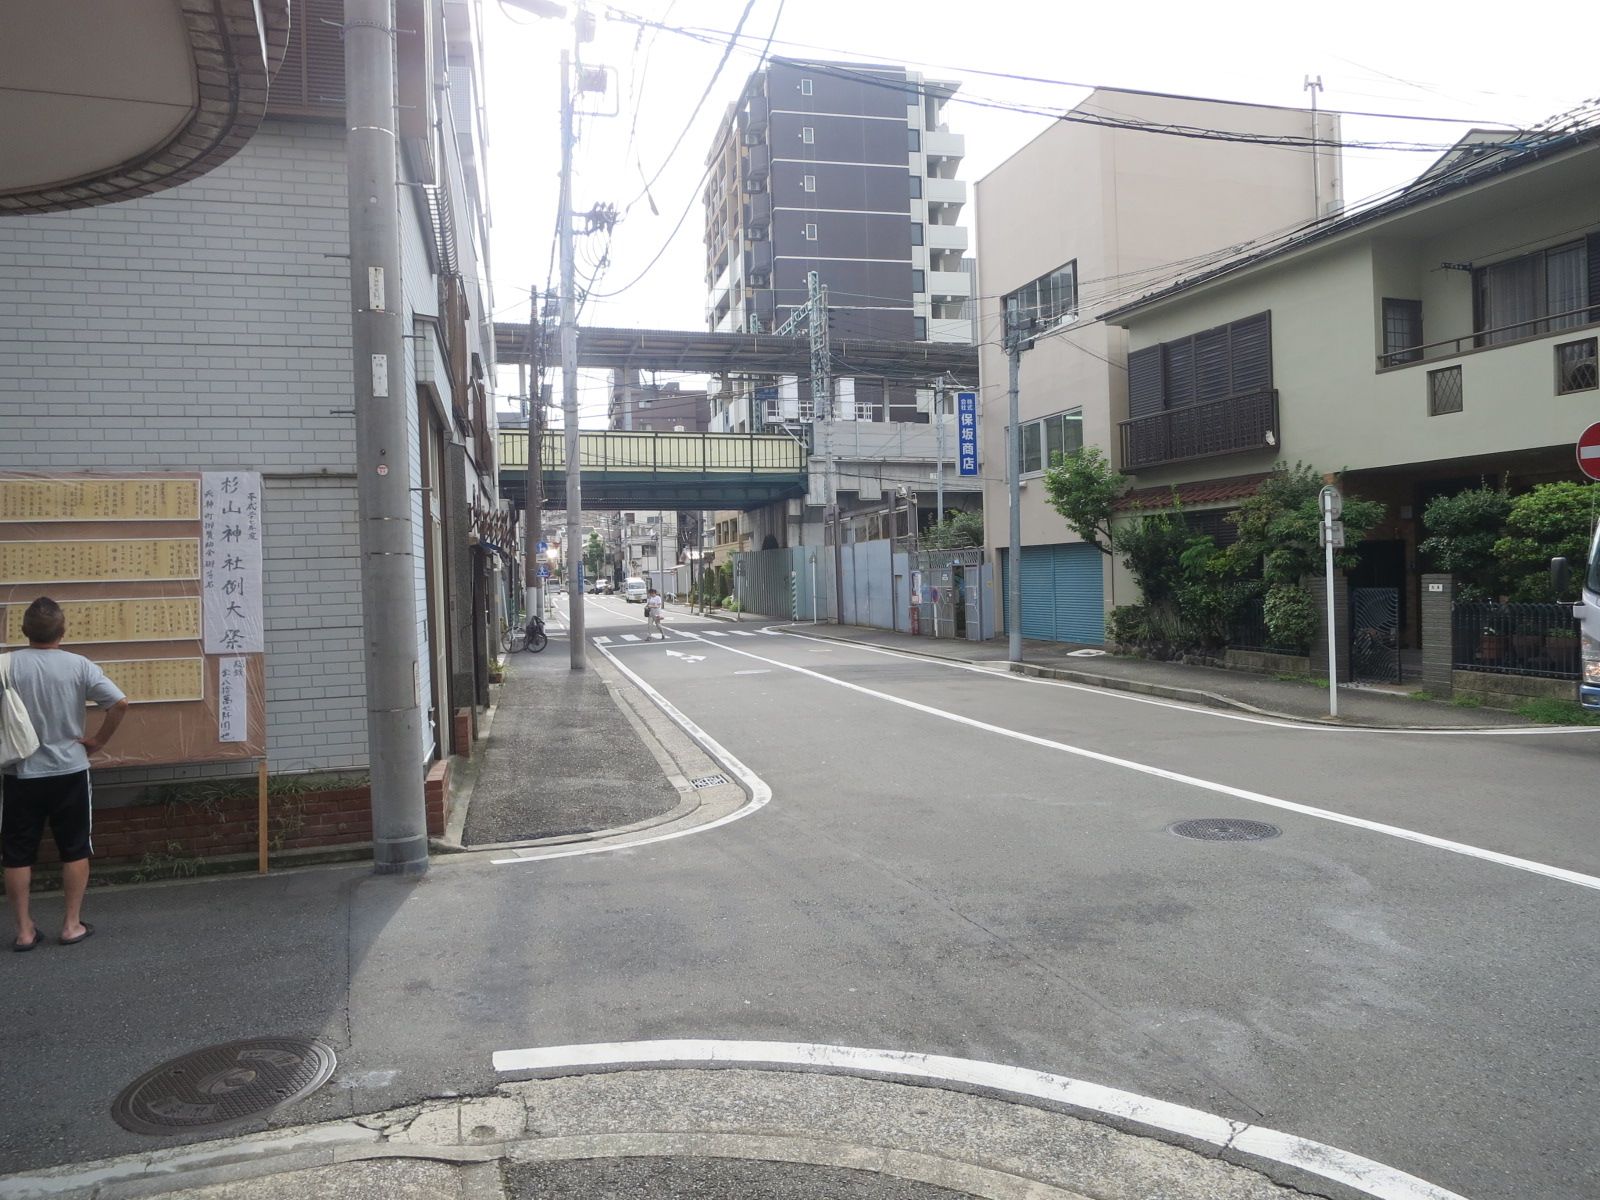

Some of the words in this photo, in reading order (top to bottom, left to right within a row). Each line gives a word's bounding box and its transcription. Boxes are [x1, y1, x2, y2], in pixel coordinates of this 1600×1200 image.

[961, 413, 974, 470] 保坂商店
[220, 476, 245, 650] 杉山神社例大祭
